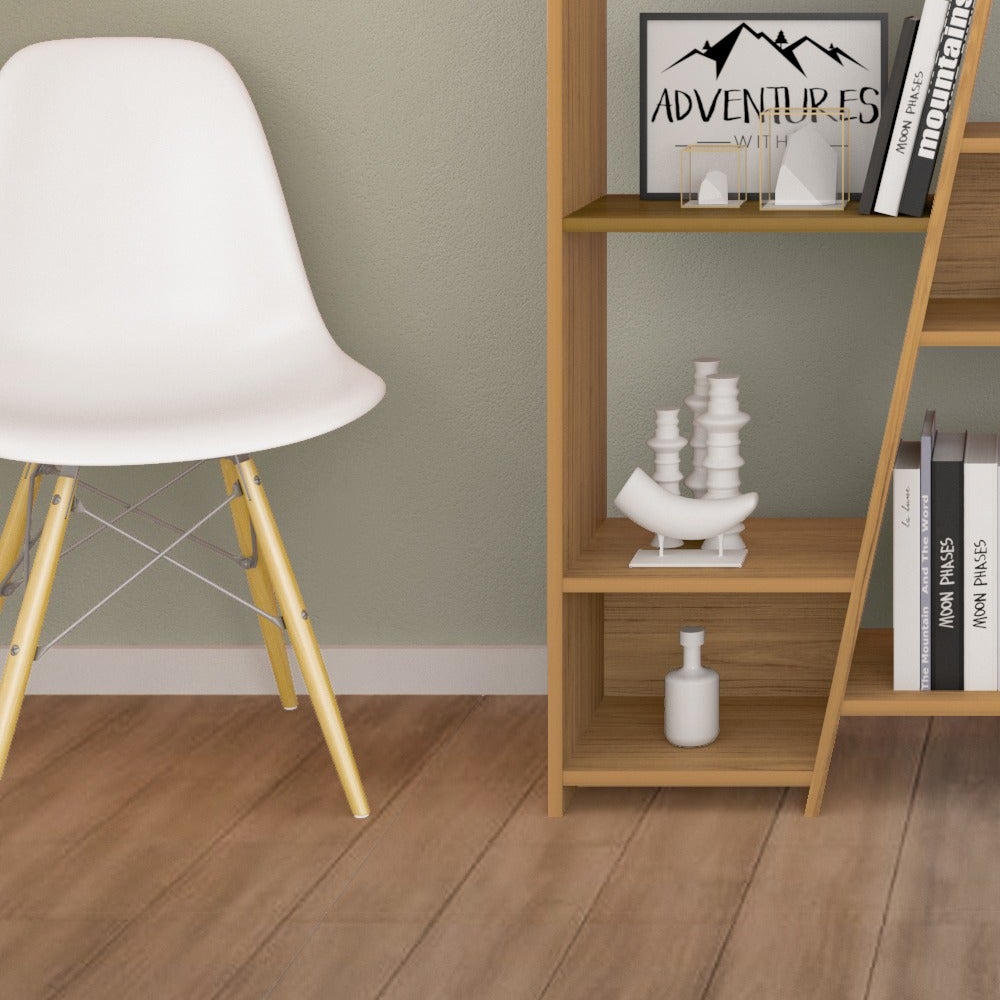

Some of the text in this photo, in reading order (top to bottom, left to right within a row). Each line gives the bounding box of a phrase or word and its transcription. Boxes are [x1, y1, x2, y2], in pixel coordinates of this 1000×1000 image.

[651, 87, 881, 125] ADVENTURES
[895, 70, 925, 155] MOON PHASES
[920, 494, 929, 689] The Mountain And The Word
[938, 537, 956, 629] MOON PHASES
[973, 539, 988, 629] MOON PHASES
